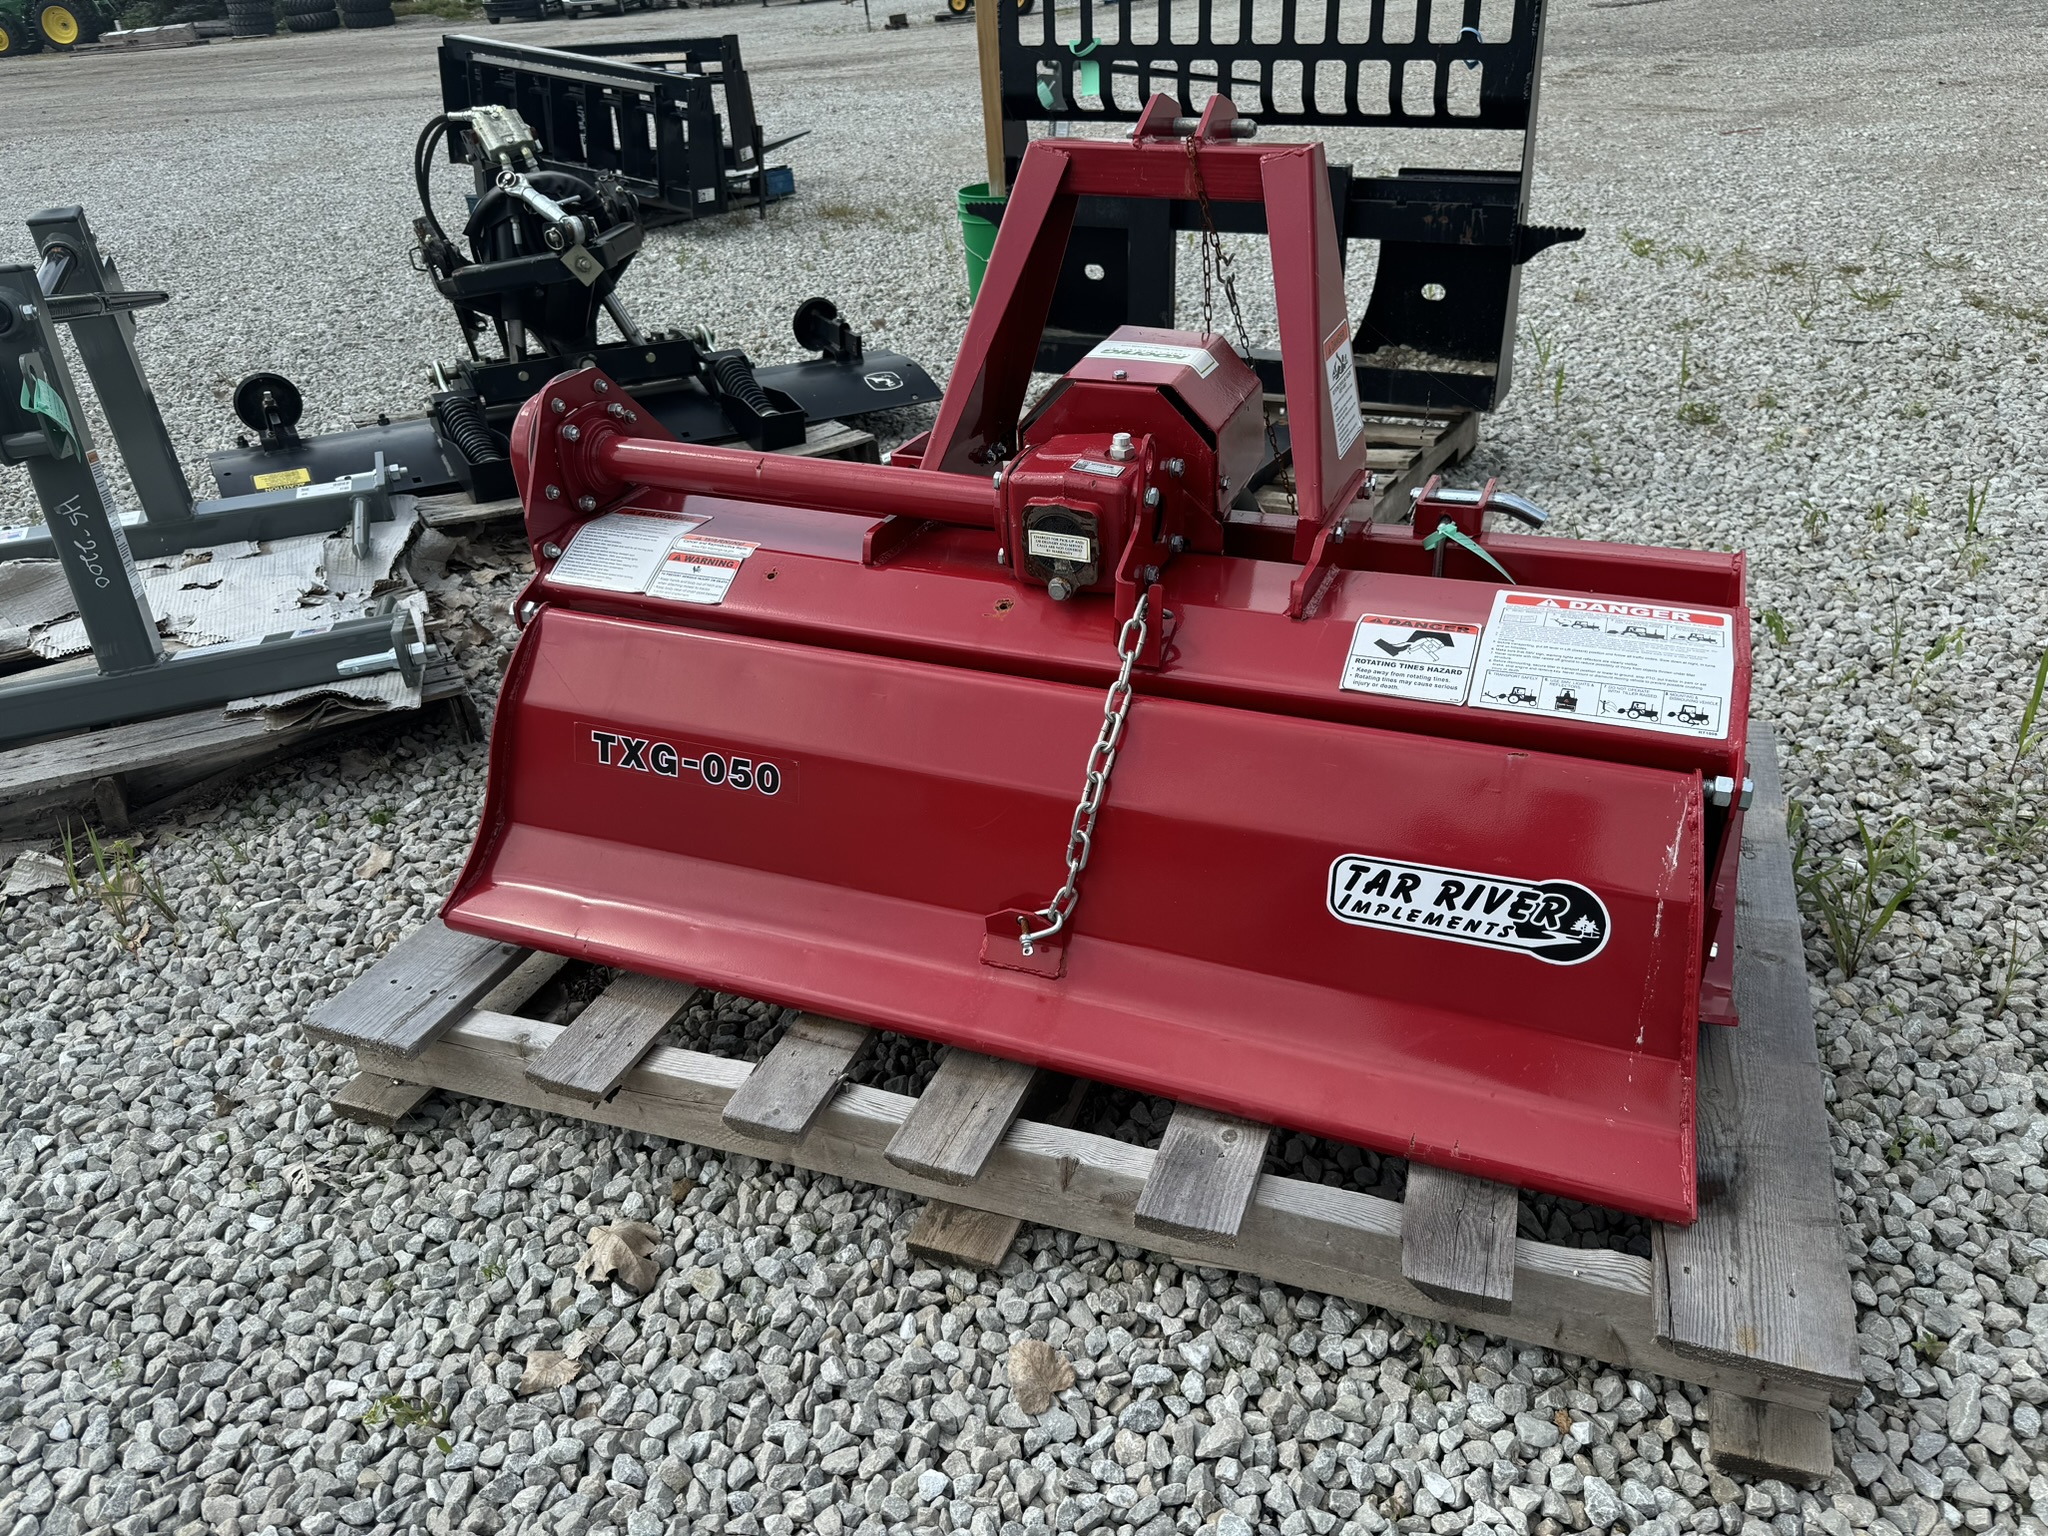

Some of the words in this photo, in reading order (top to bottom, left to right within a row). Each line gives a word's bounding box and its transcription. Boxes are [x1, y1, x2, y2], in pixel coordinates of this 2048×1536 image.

[54, 494, 110, 588] HS-2200
[684, 555, 734, 568] WARNING
[1569, 601, 1691, 621] DANGER
[1388, 619, 1470, 633] DANGER
[1355, 657, 1396, 668] ROTATING
[1399, 663, 1425, 671] TINES
[1427, 666, 1463, 675] HAZARD
[1352, 680, 1370, 688] injury
[1380, 682, 1399, 690] death.
[1354, 673, 1381, 682] Rotating
[1434, 682, 1458, 690] serious
[1406, 673, 1431, 682] rotating
[1433, 675, 1451, 683] tines.
[591, 730, 781, 796] TXG-050
[1343, 864, 1422, 904] TAR
[1432, 879, 1571, 931] RIVER
[1337, 894, 1517, 938] IMPLEMENTS
